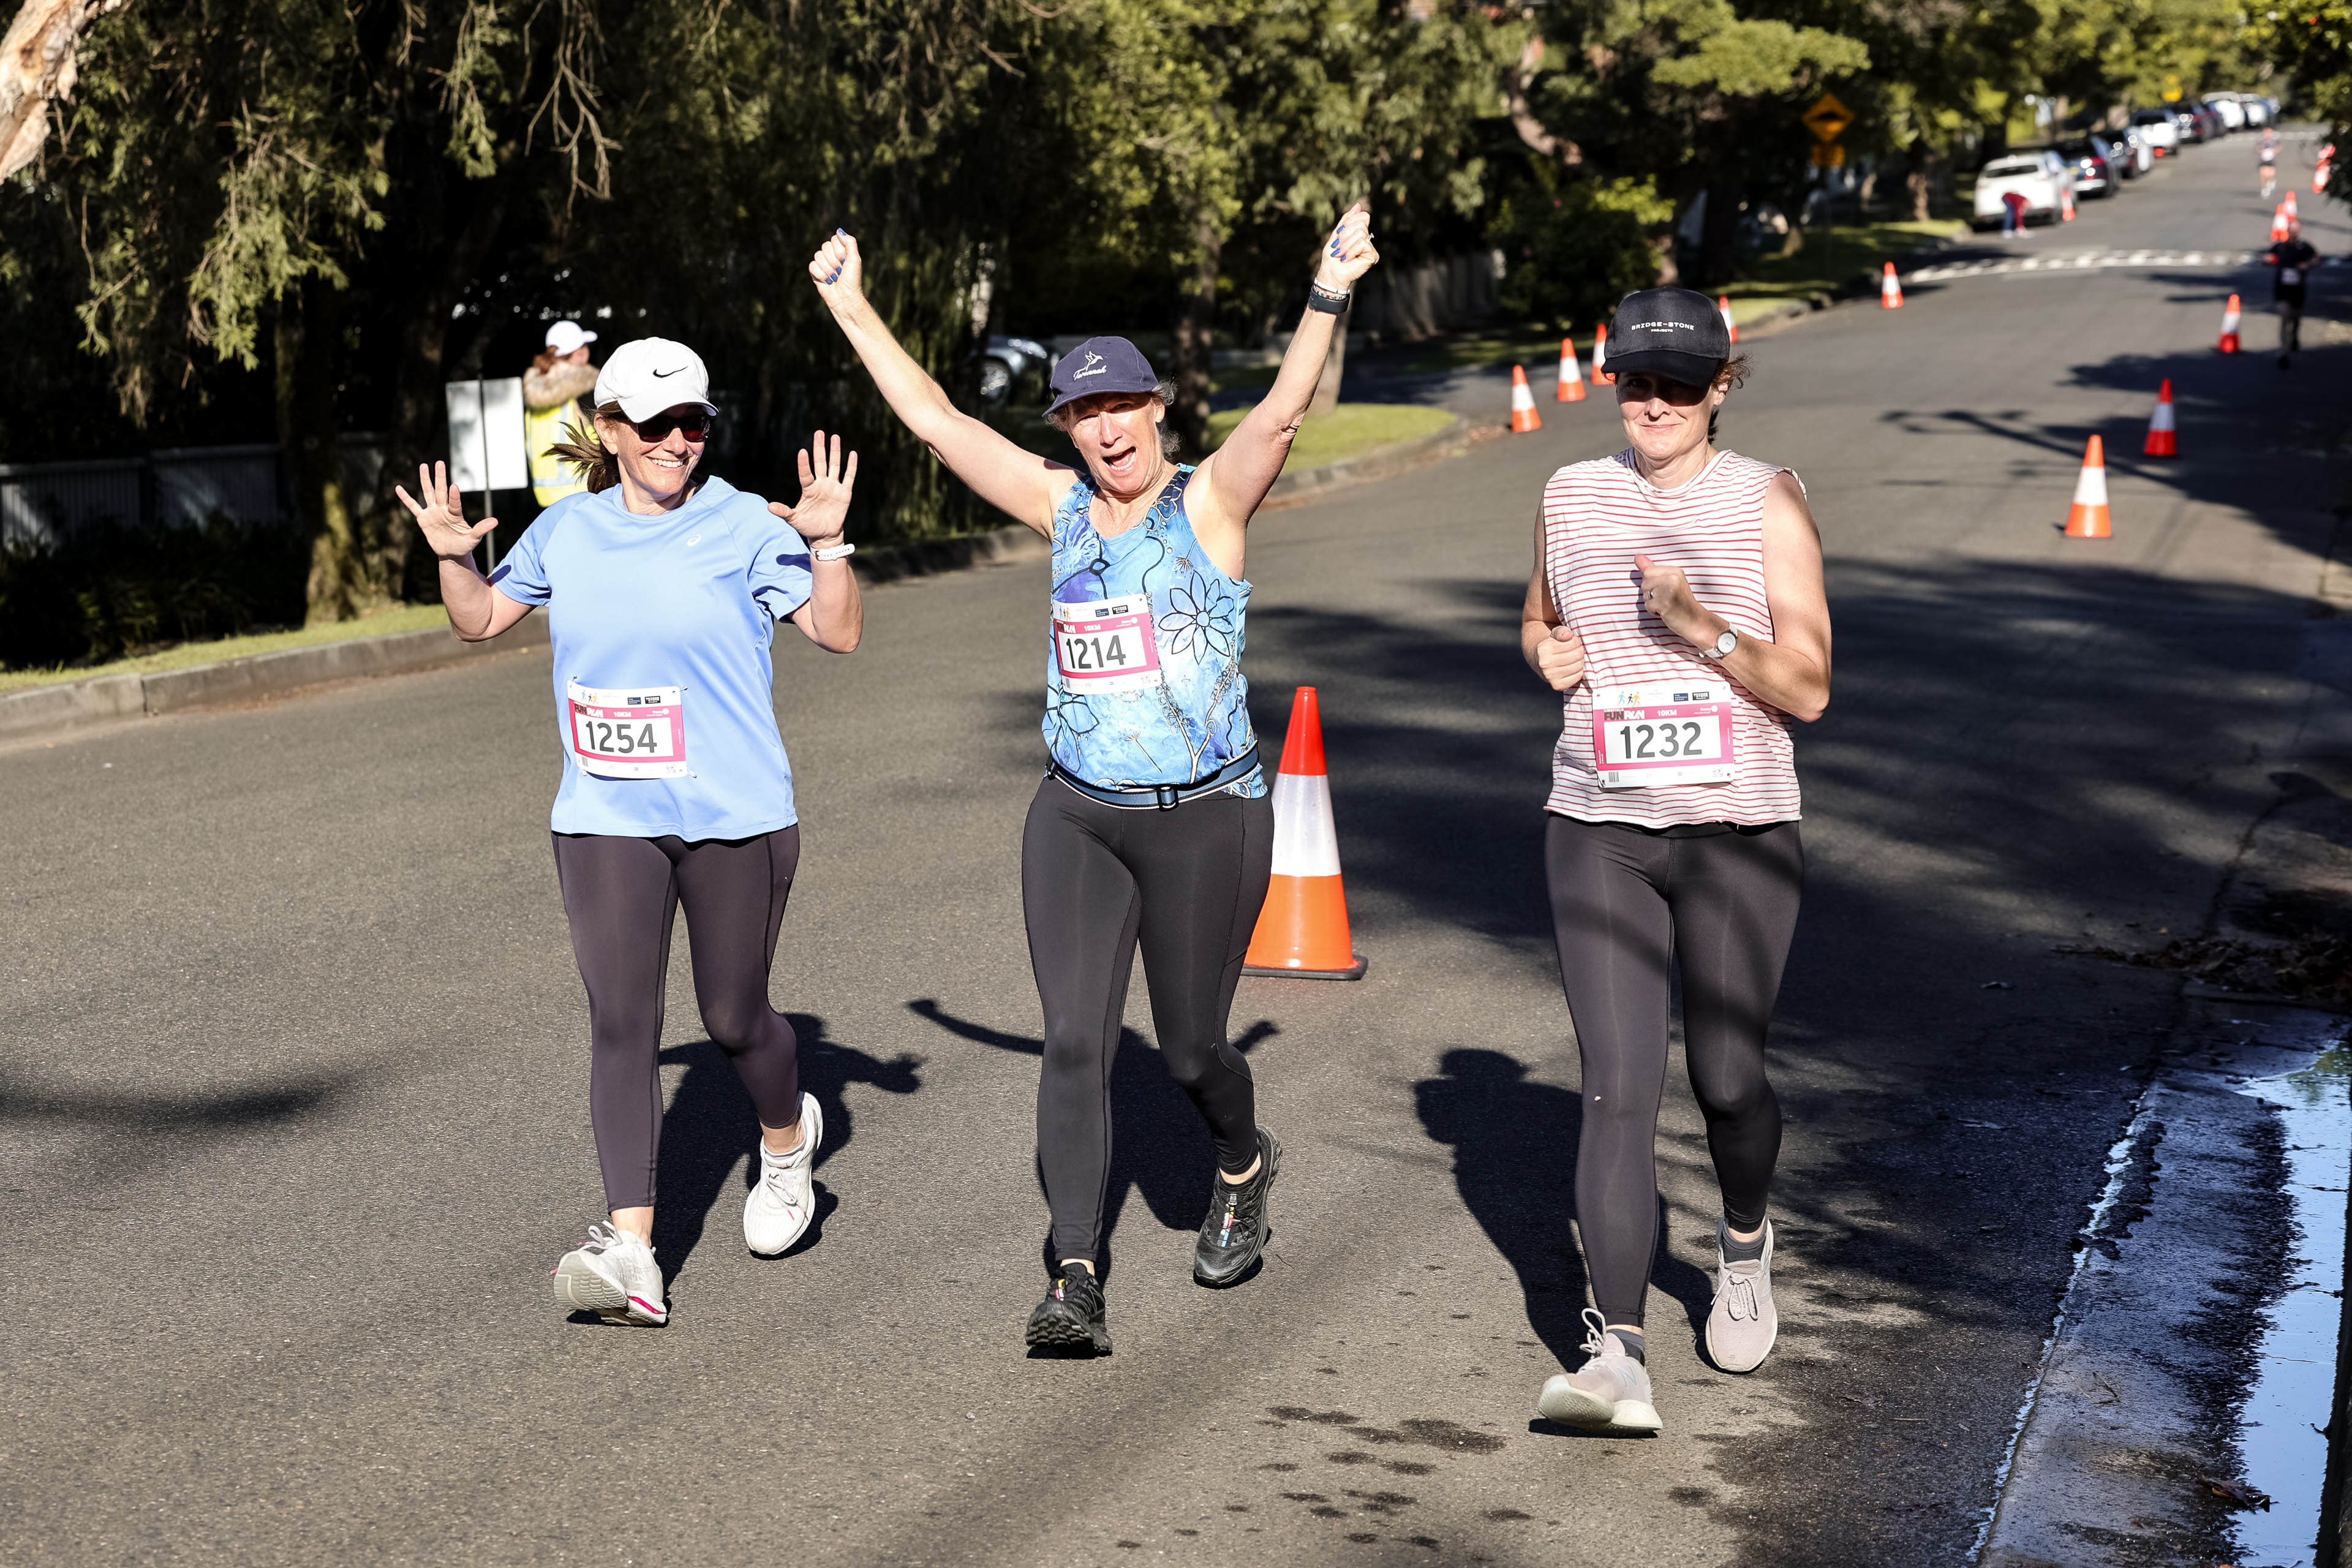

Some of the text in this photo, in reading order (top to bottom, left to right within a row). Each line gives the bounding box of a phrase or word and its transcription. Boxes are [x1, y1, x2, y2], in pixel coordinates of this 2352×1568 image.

[1066, 635, 1126, 669] 1214
[586, 720, 657, 753] 1254
[1620, 722, 1702, 759] 1232
